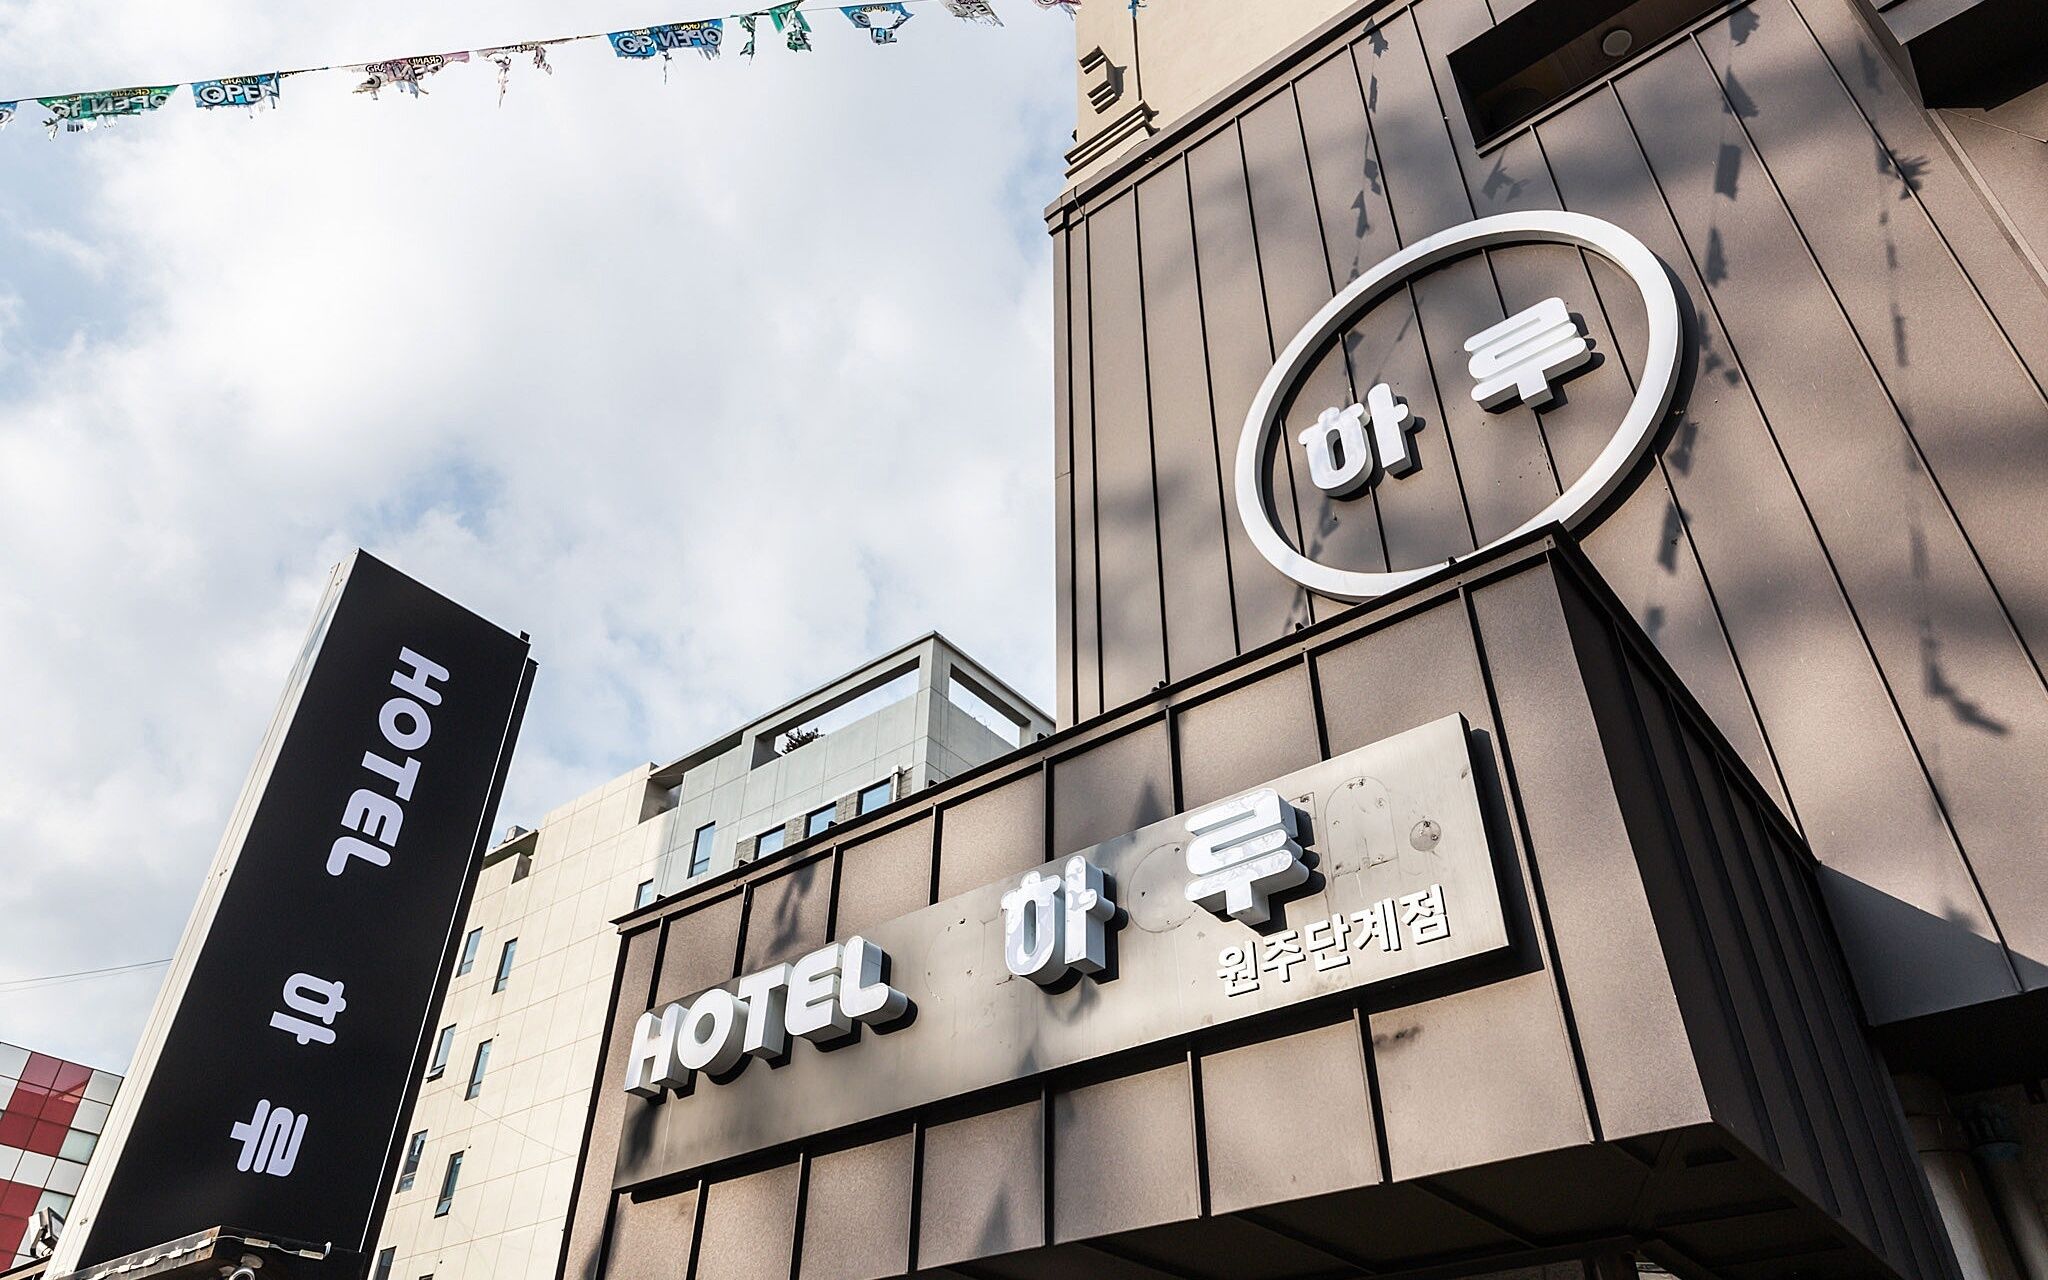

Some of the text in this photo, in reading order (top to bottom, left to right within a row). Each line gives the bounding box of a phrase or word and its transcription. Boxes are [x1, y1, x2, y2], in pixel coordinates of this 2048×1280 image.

[200, 80, 280, 105] OPEN
[326, 645, 450, 877] HOTEL
[1216, 884, 1450, 997] 원주단계점
[624, 935, 908, 1099] HOTEL
